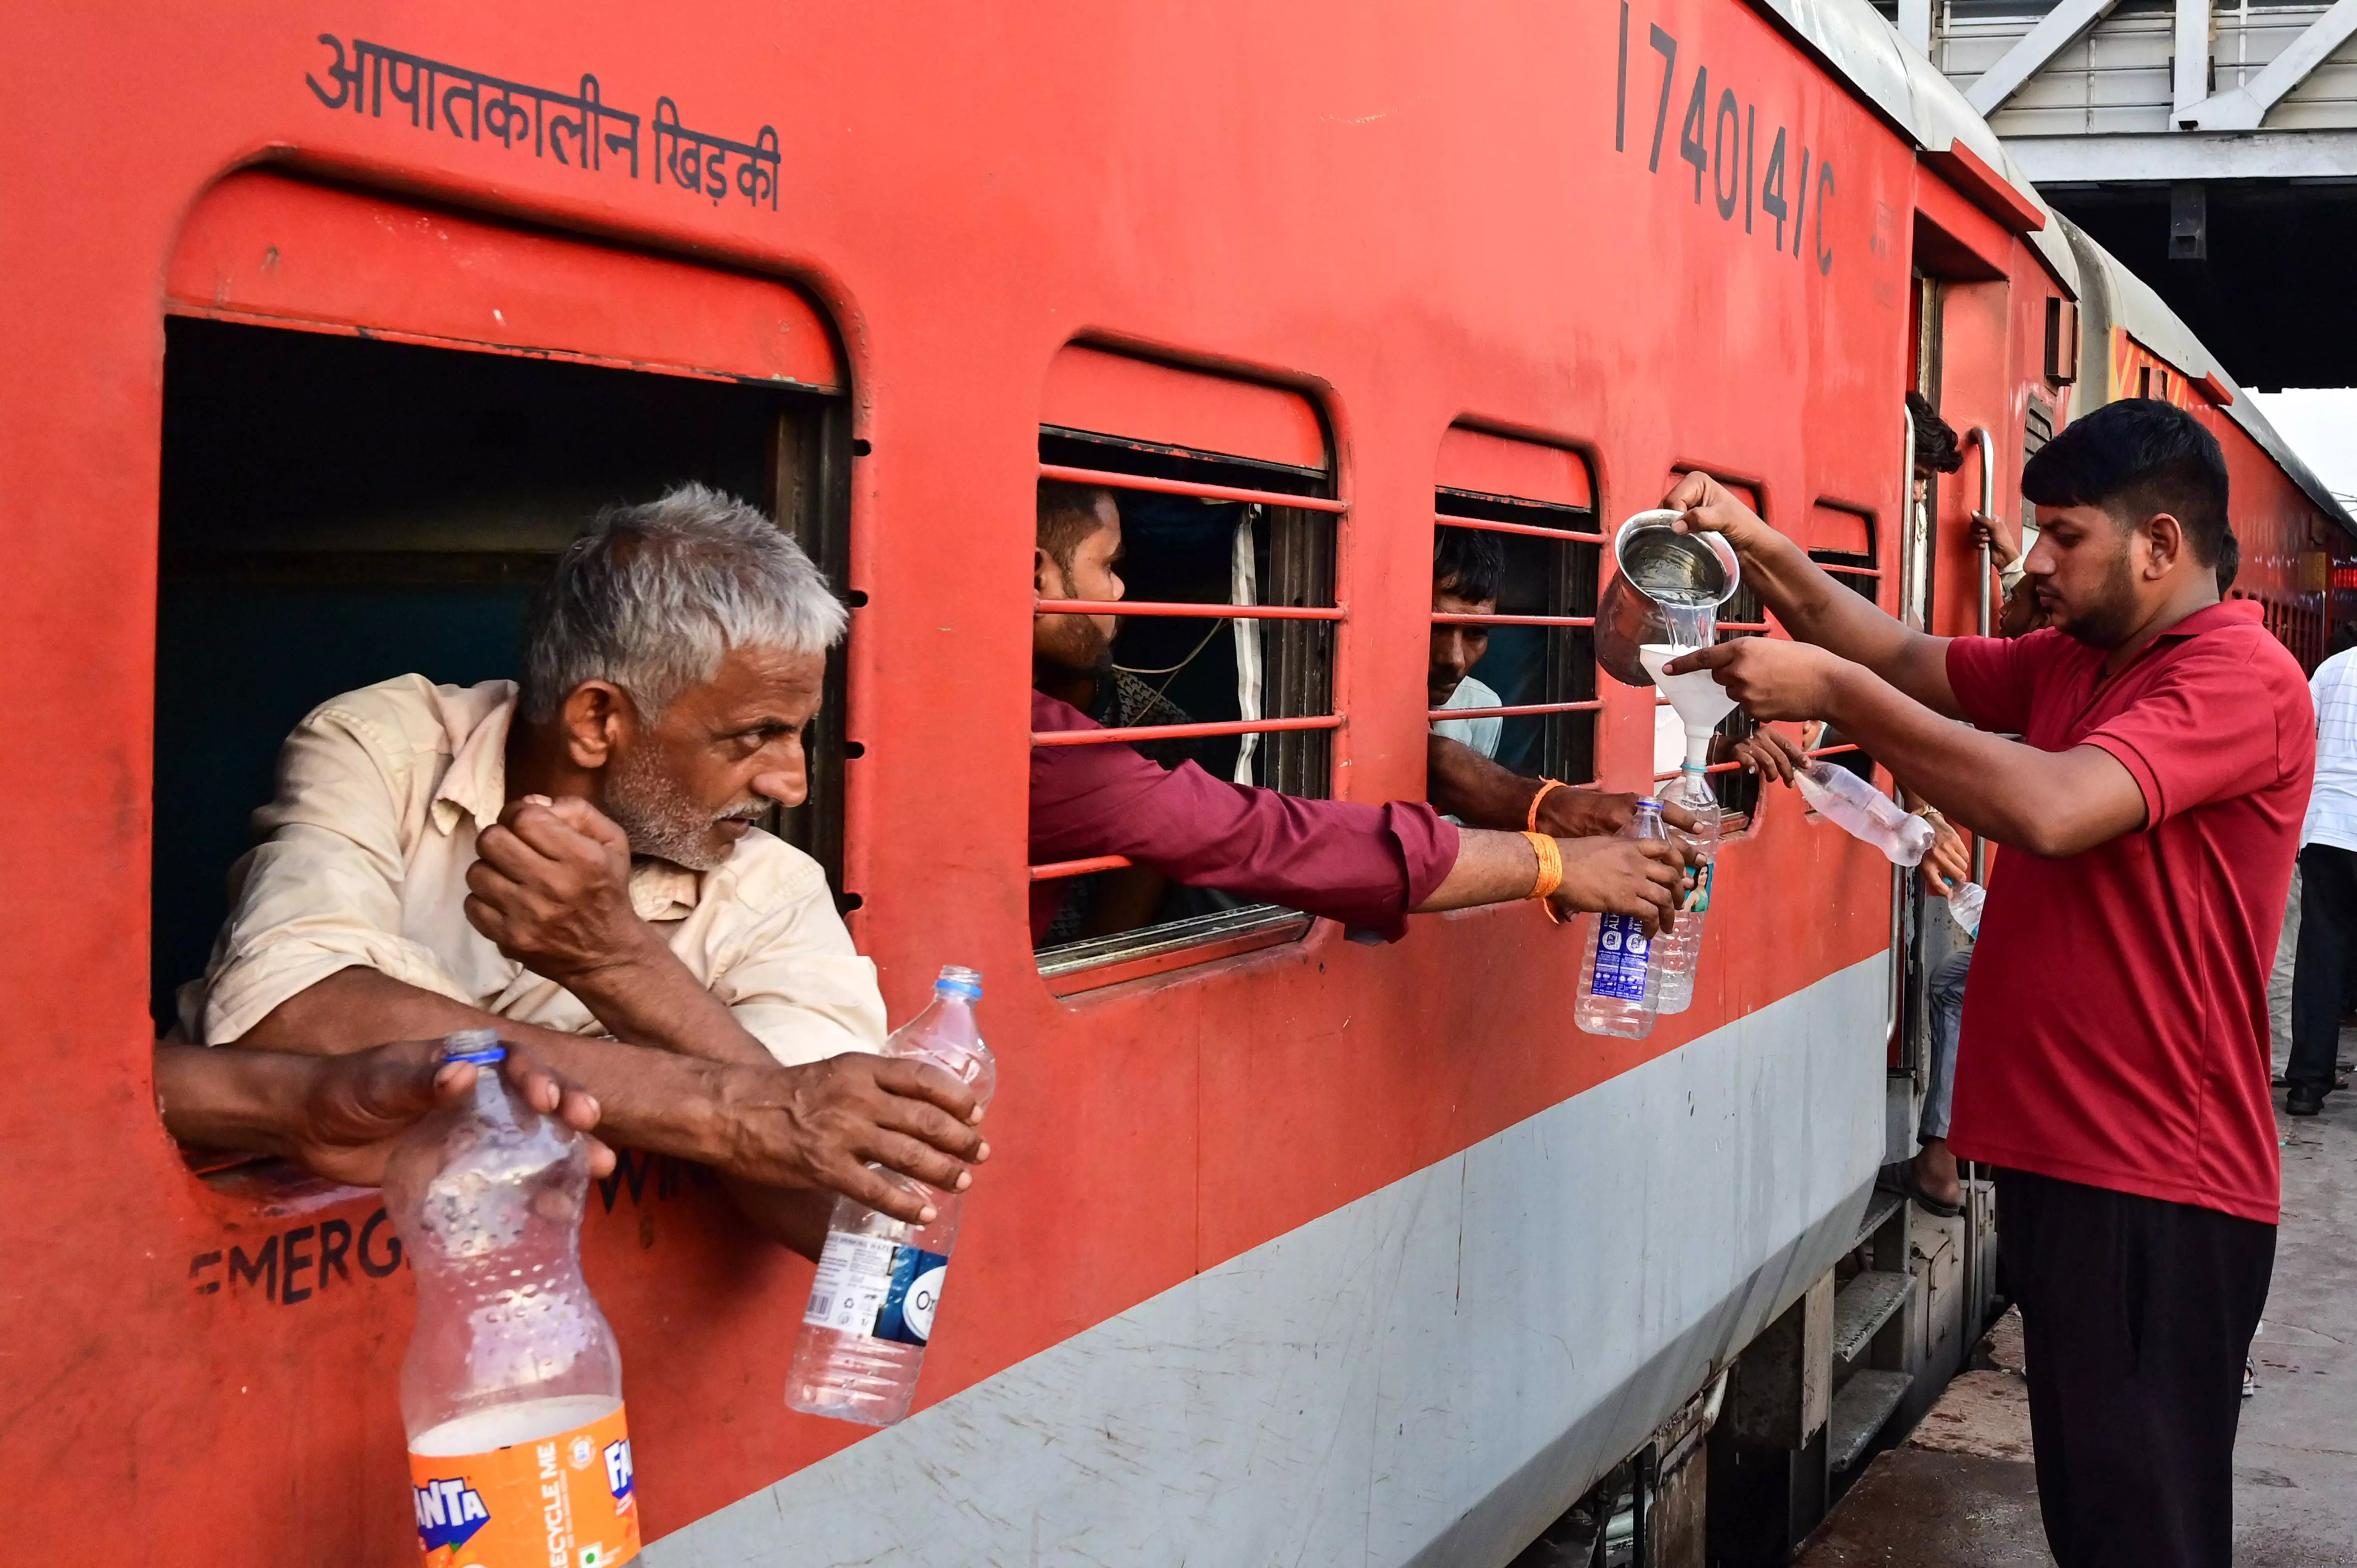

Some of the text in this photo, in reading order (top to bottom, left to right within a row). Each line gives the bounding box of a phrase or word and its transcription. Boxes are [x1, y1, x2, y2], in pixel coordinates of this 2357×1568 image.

[305, 33, 781, 211] आपातकालीन खिड़की
[189, 1207, 411, 1305] EMERG
[537, 1441, 558, 1480] ME
